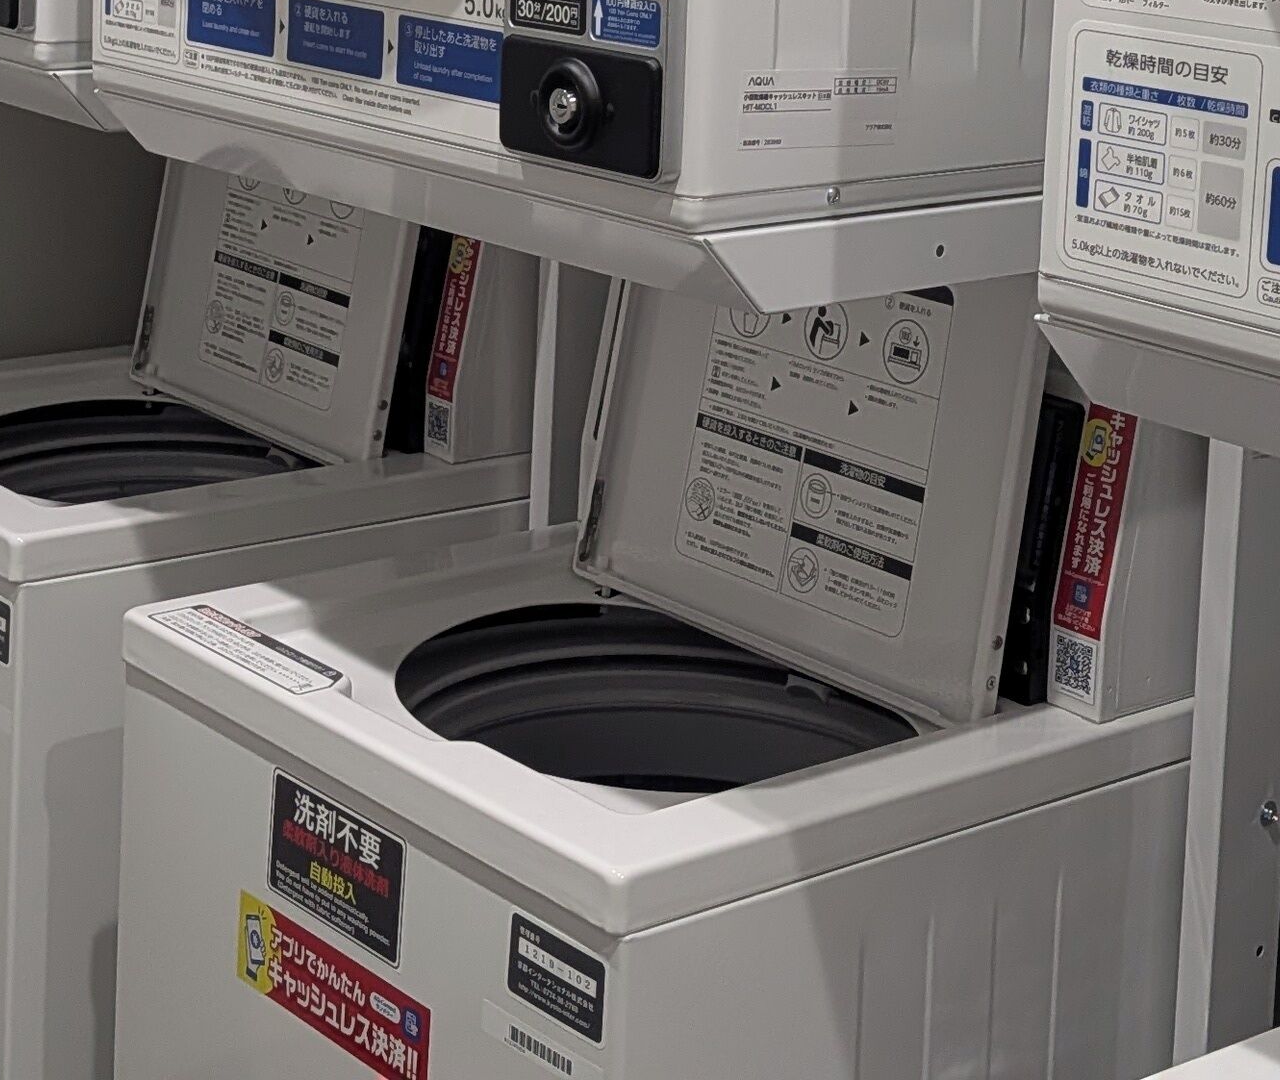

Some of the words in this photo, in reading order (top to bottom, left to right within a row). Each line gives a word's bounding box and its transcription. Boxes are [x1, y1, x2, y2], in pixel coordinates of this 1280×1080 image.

[414, 42, 446, 58] 取り出す
[415, 24, 497, 52] 停止したあと洗濯物を
[748, 76, 775, 86] AQUA
[1106, 49, 1229, 85] 乾燥時間の目安
[1128, 114, 1161, 129] ワイシャツ
[1209, 133, 1241, 150] 約30分
[1206, 192, 1237, 210] 約60分
[1083, 413, 1125, 577] キャッシュレス決済
[293, 789, 381, 870] 洗剤不要
[309, 860, 356, 905] 自動投入
[271, 926, 366, 1007] アプリでかんたん
